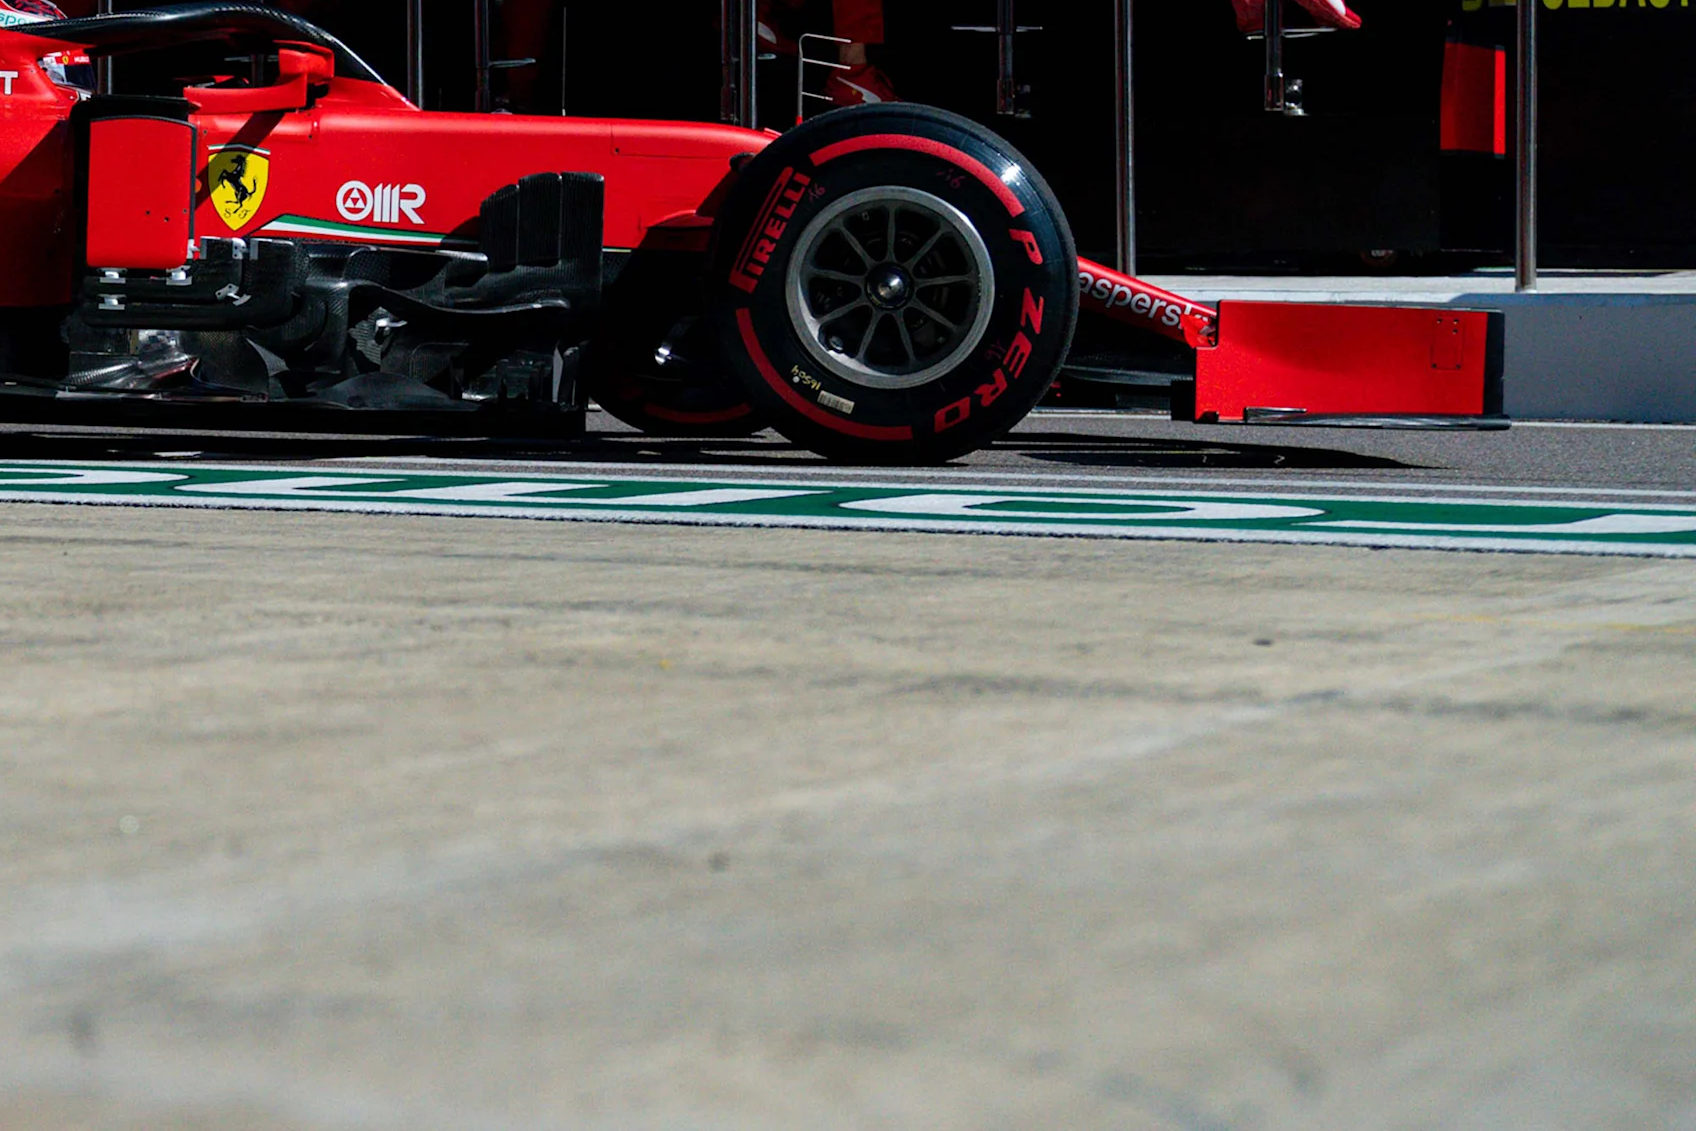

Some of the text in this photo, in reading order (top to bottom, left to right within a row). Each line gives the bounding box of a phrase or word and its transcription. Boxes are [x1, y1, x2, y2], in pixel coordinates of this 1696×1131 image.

[729, 166, 811, 294] PIRELLI
[934, 228, 1044, 434] P ZERO
